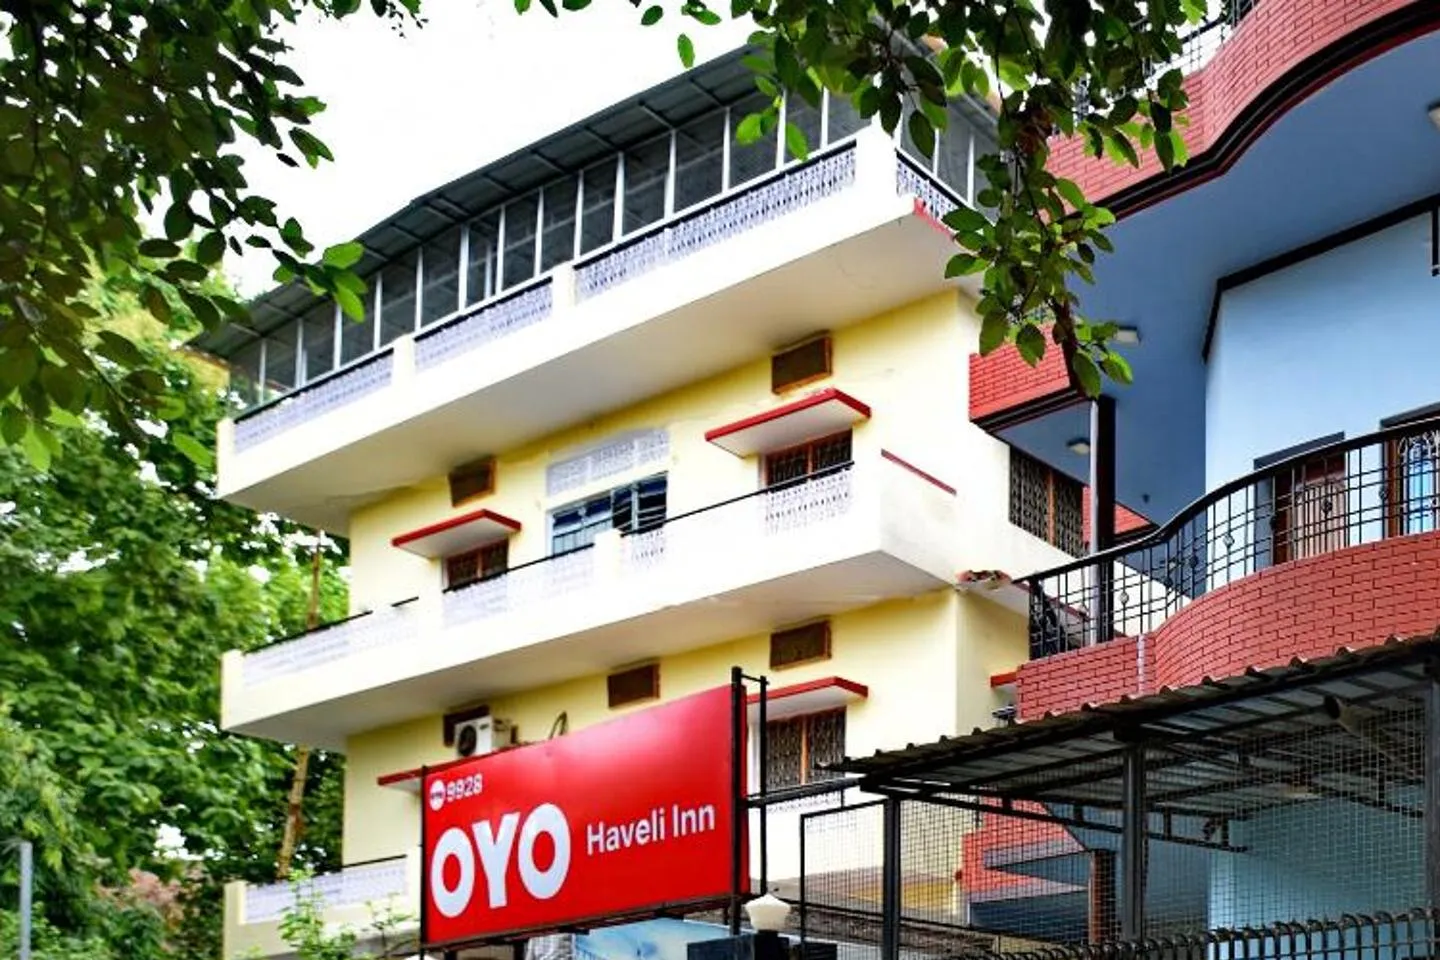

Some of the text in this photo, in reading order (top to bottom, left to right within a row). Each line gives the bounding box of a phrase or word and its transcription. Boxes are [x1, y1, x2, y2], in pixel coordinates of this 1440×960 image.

[446, 773, 483, 802] 9928
[587, 804, 715, 856] Haveli Inn
[430, 802, 571, 918] OYO
